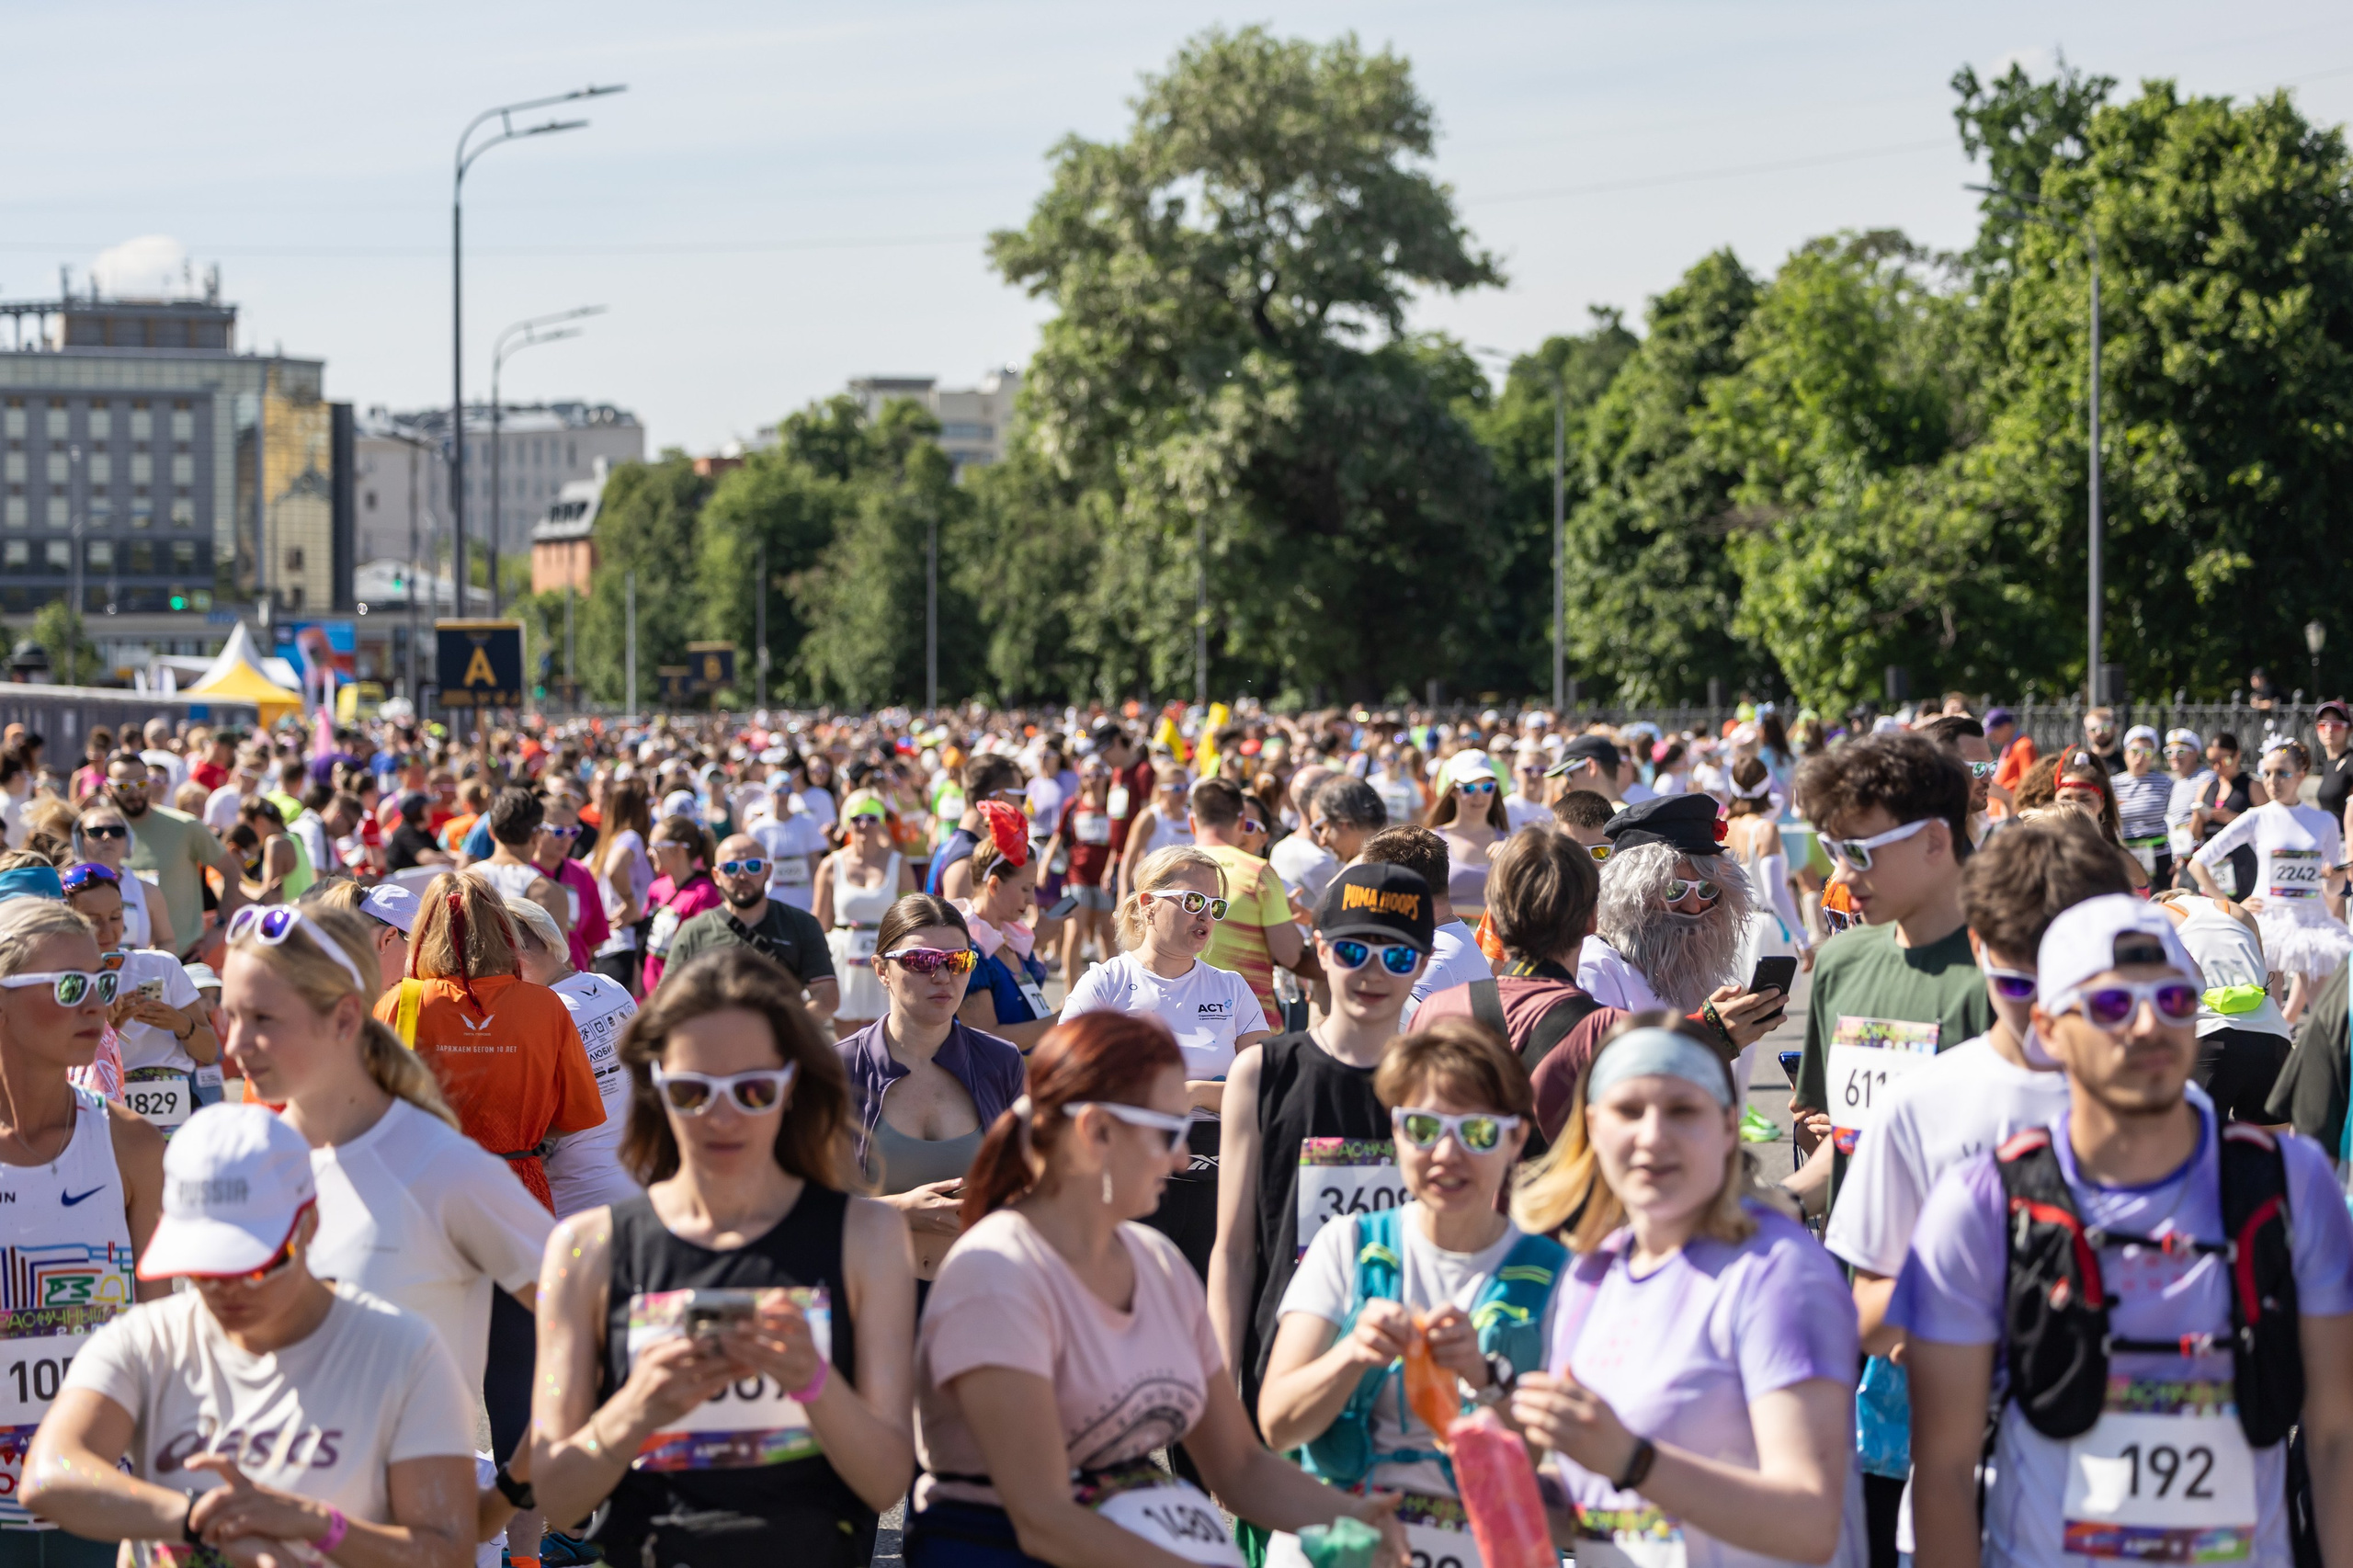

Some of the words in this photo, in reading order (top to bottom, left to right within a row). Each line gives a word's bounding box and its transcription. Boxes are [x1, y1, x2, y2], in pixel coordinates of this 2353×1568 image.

[463, 645, 497, 687] A
[2277, 865, 2317, 881] 2242
[1341, 883, 1378, 911] PUMA
[1379, 891, 1420, 921] HOOPS
[436, 1044, 472, 1052] ЗАРЯЖАЕМ
[589, 1044, 613, 1062] ЛЮБИ
[124, 1092, 178, 1115] 1829
[2119, 1443, 2214, 1500] 192
